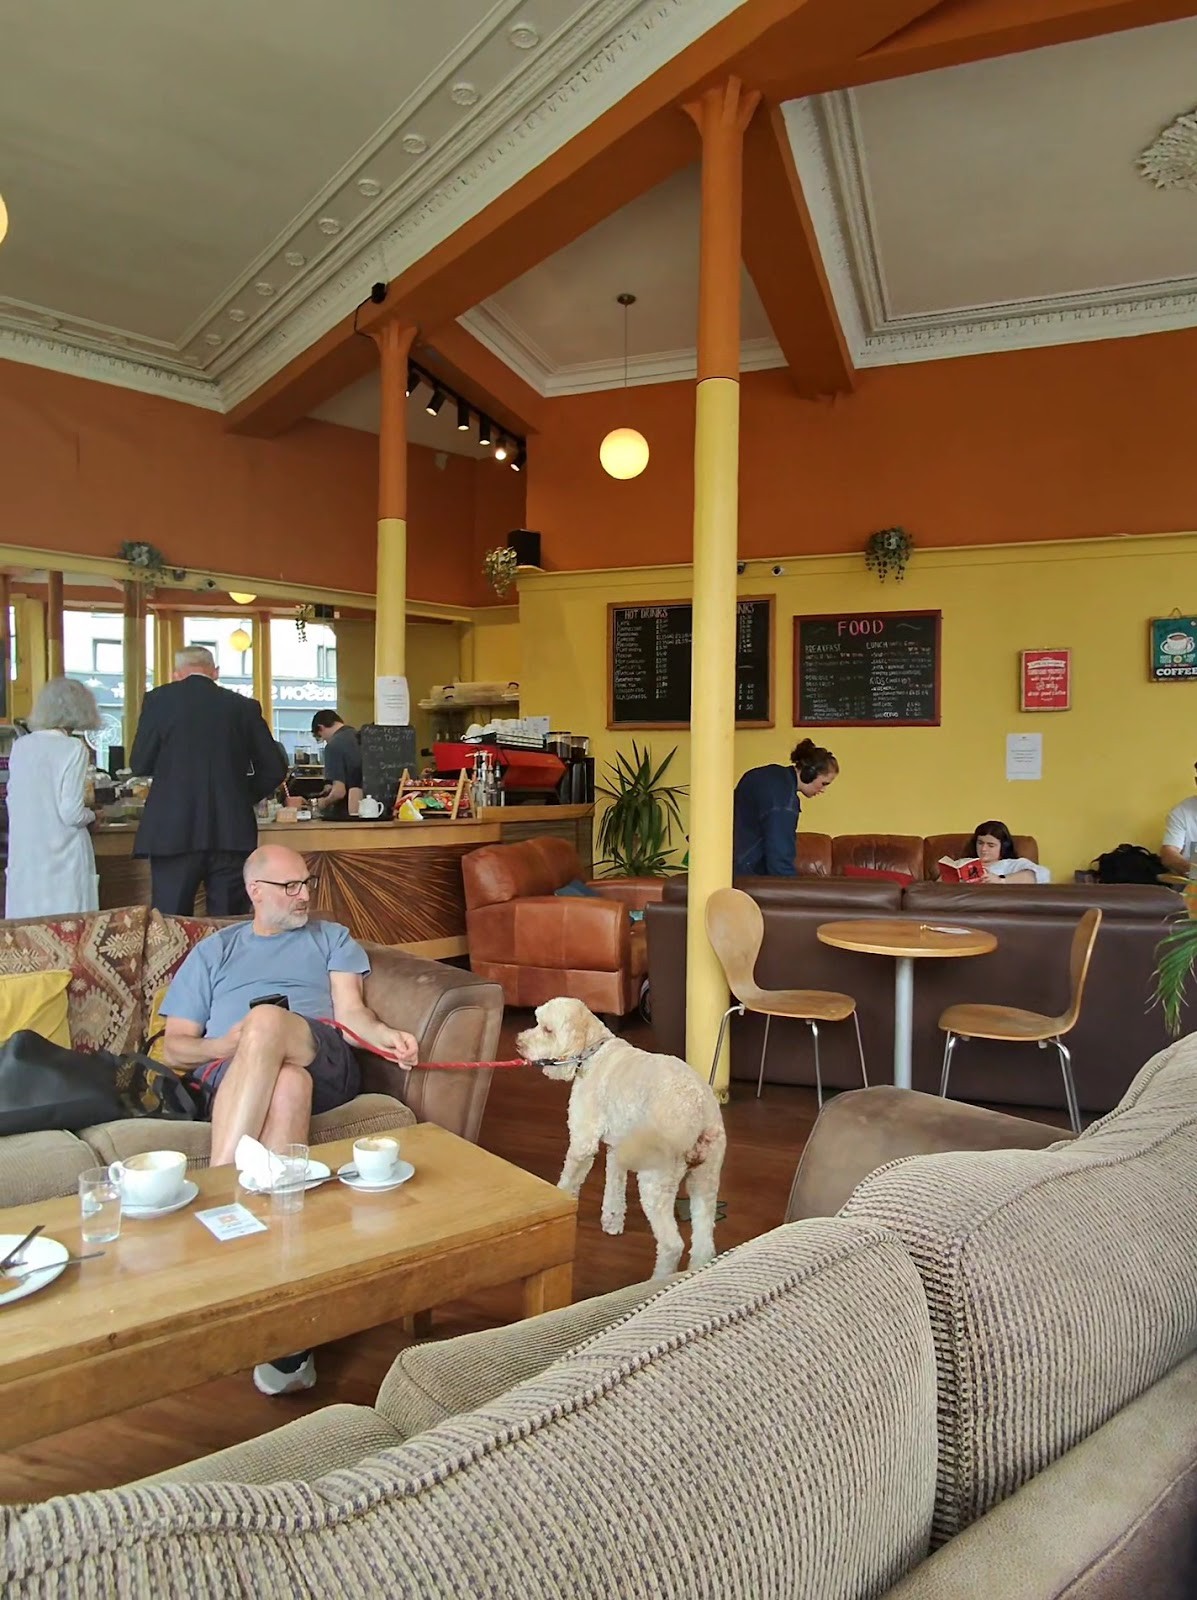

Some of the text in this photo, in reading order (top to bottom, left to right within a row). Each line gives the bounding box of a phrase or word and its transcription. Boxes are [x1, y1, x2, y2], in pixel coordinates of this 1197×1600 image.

[624, 608, 668, 620] HOT DRINKS
[838, 619, 884, 637] FOOD
[804, 643, 842, 654] BREAKFAST
[866, 641, 889, 651] LUNCH
[1156, 667, 1197, 677] COFFEE
